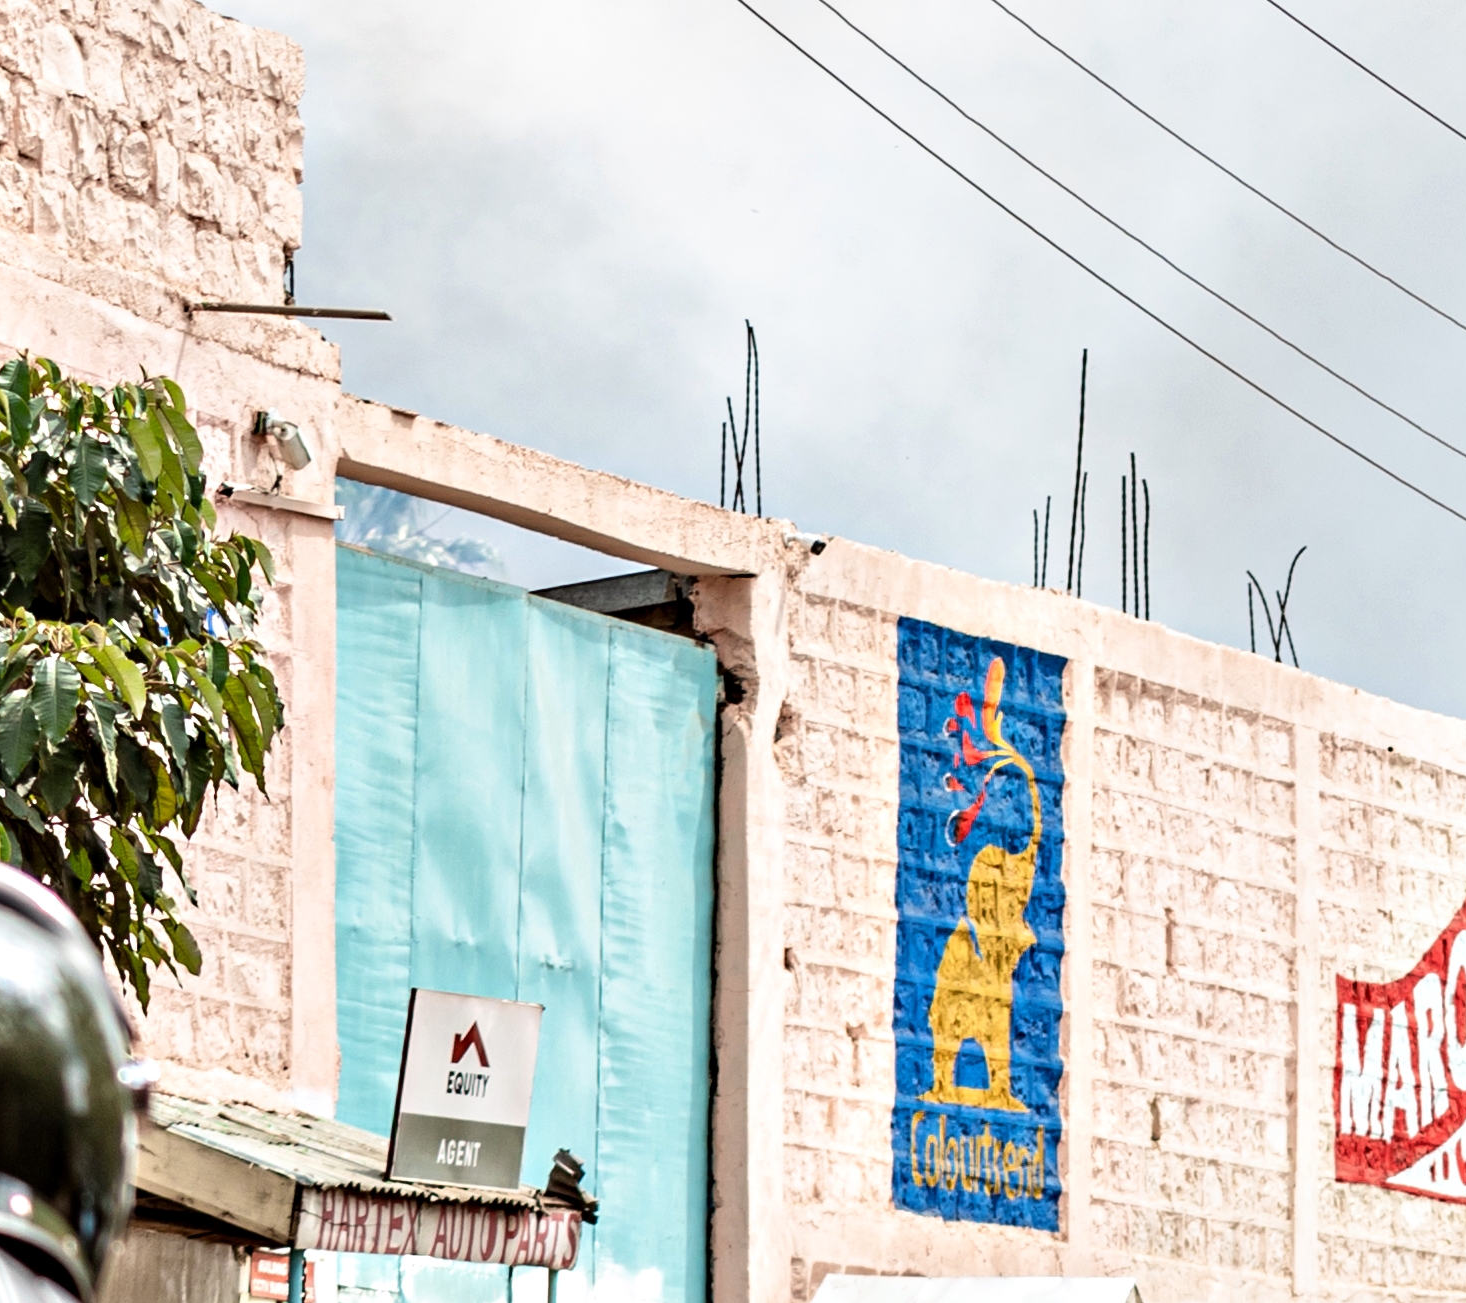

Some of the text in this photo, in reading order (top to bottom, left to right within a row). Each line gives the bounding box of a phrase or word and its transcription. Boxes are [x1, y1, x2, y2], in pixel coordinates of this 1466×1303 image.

[446, 1070, 490, 1097] EQUITY
[436, 1138, 482, 1168] AGENT
[911, 1110, 1045, 1200] Colourtrend
[317, 1190, 581, 1270] HARTEX AUTO PARTS
